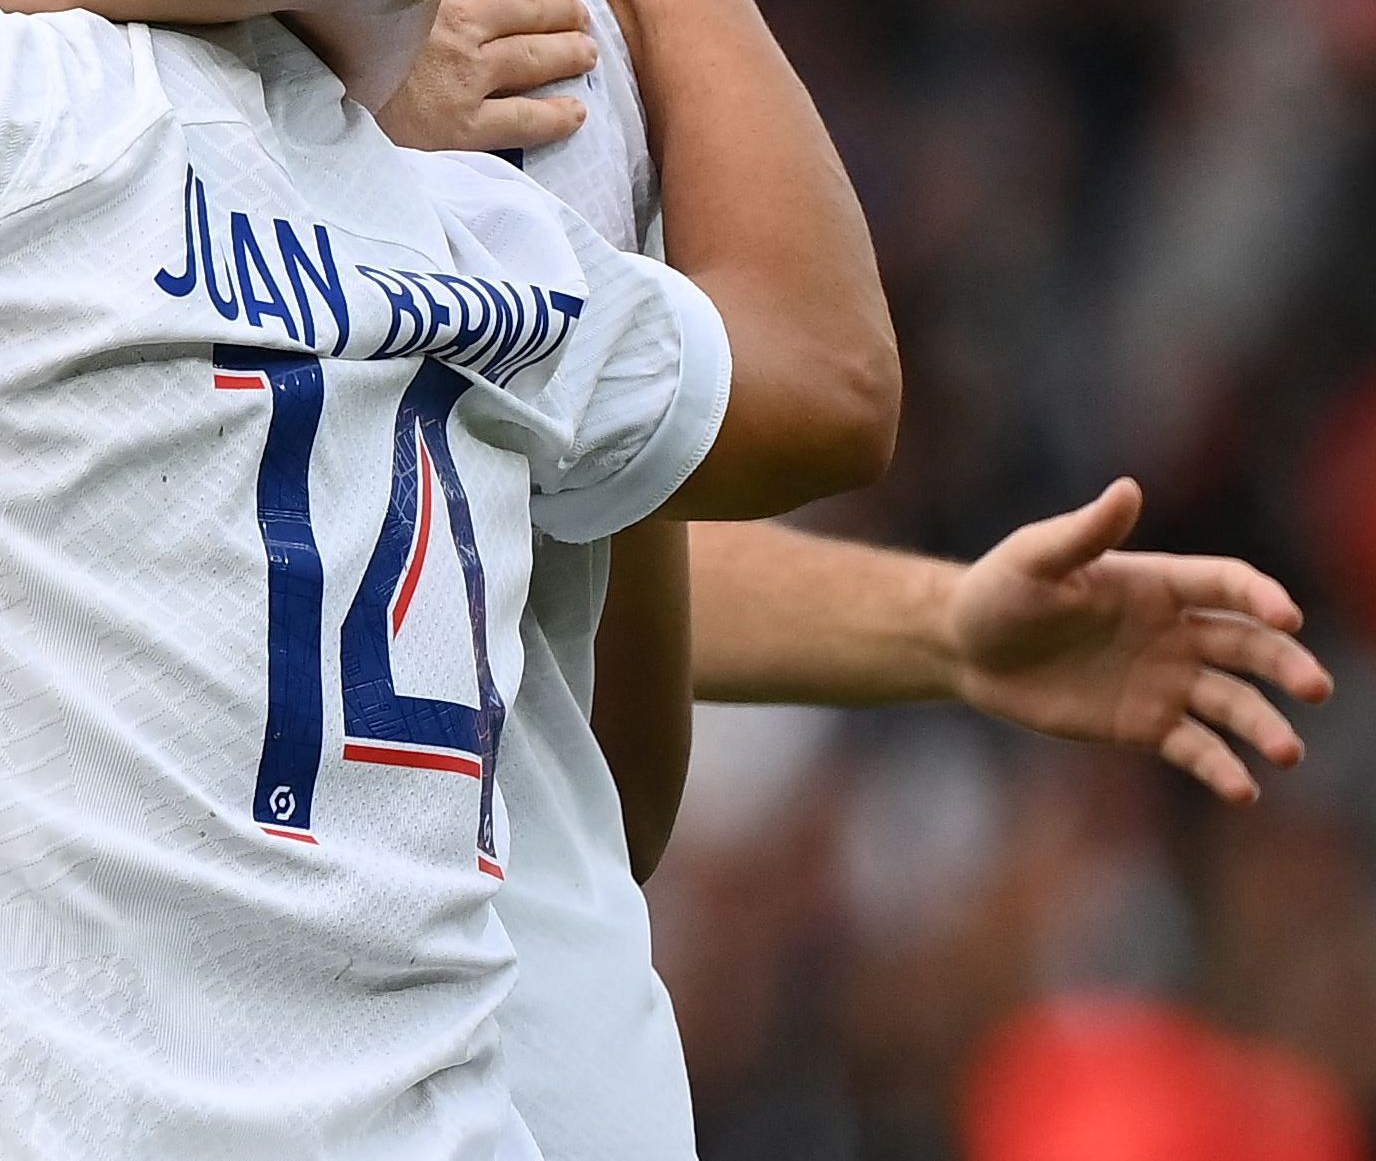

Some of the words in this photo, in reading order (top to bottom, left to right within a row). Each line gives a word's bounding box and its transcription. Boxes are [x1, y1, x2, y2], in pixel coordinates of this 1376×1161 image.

[154, 162, 350, 358] JUAN
[355, 264, 585, 390] BERNAT
[213, 342, 506, 881] 14
